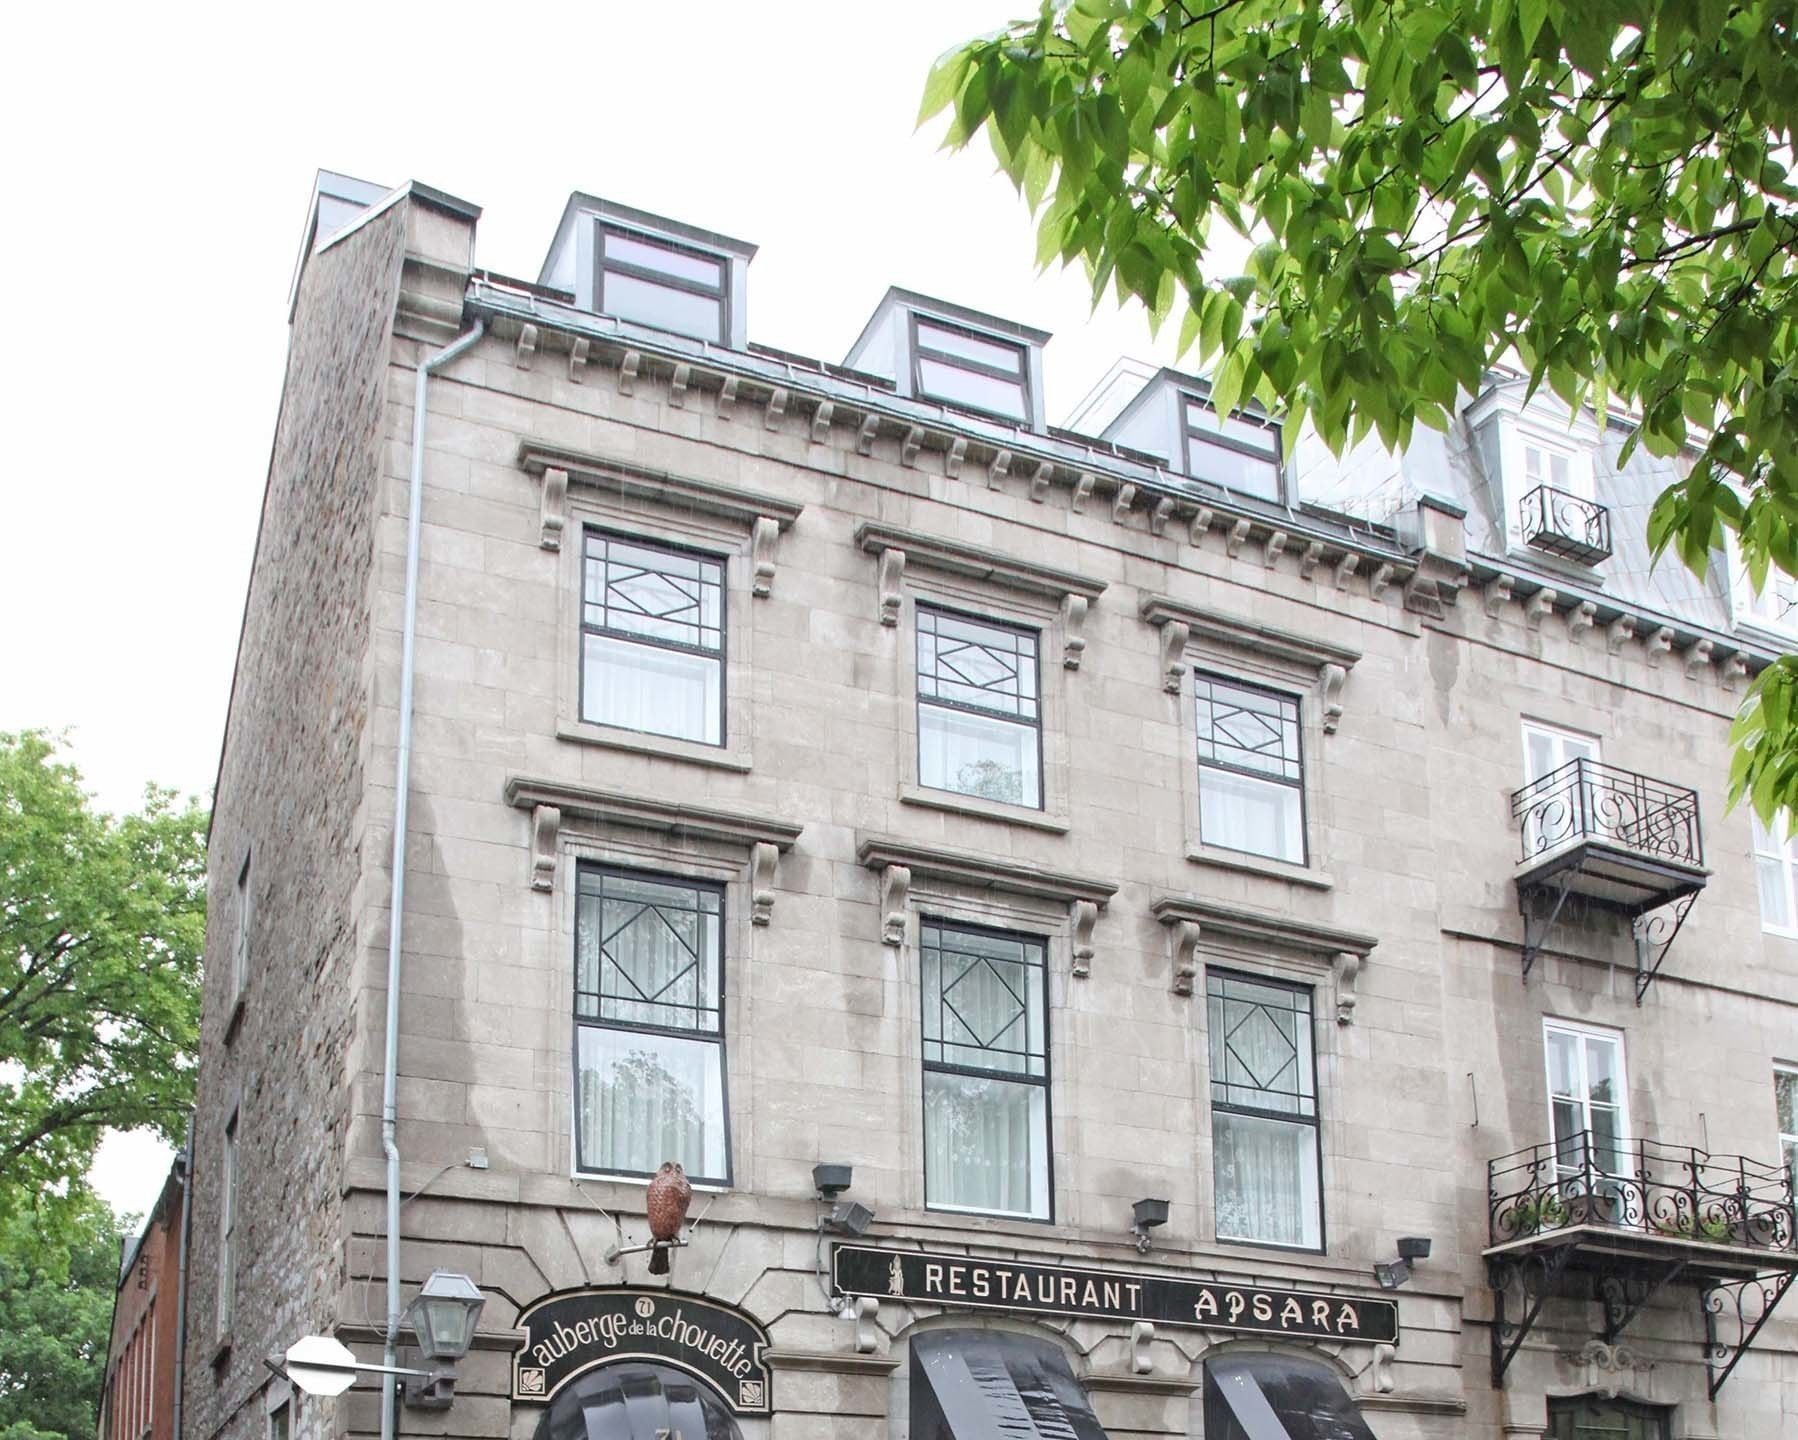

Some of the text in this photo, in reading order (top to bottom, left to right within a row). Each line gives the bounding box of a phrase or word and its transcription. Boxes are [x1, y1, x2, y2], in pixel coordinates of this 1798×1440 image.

[639, 1301, 651, 1314] 71
[925, 1263, 1360, 1334] RESTAURANT APSARA
[532, 1309, 752, 1379] auberge de la chouette
